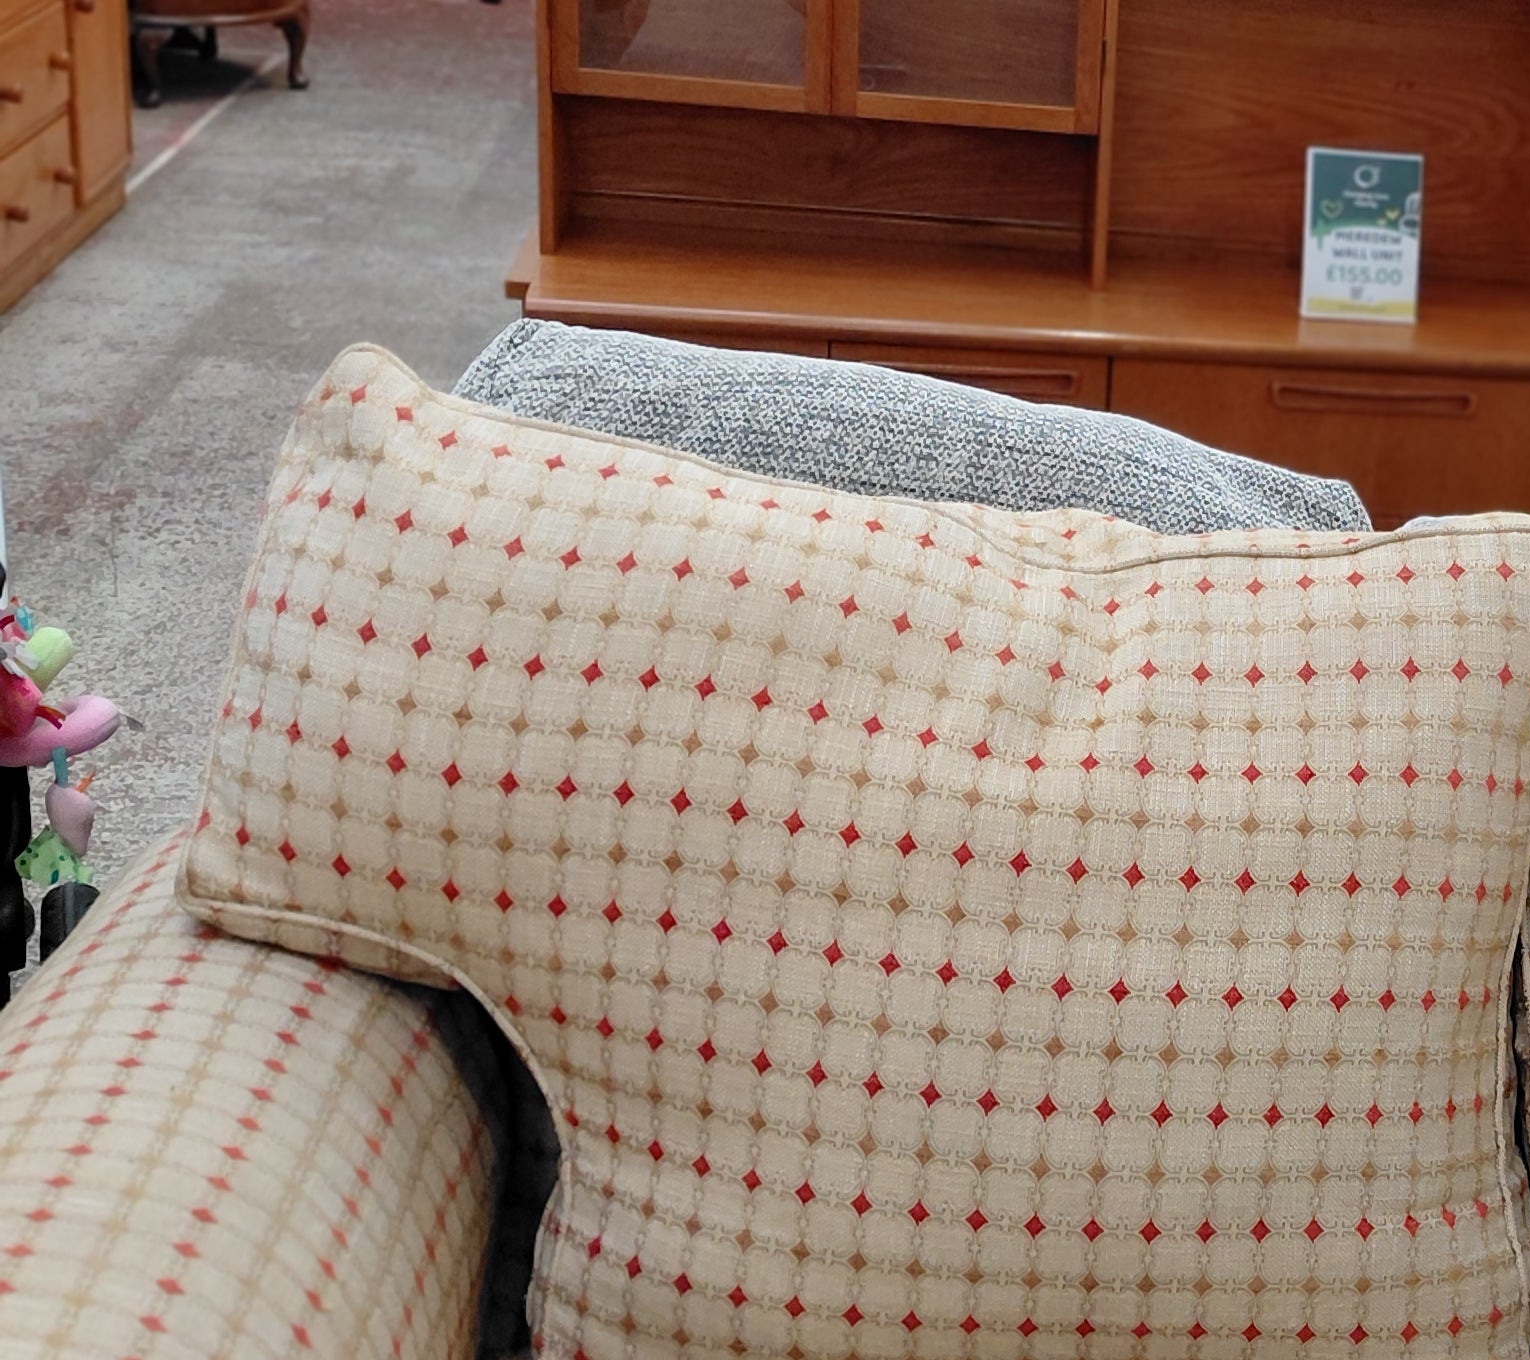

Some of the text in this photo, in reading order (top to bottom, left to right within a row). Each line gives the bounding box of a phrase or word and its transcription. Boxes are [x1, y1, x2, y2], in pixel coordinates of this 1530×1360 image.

[1332, 247, 1403, 262] WALL UNIT
[1325, 264, 1403, 286] £155.00
